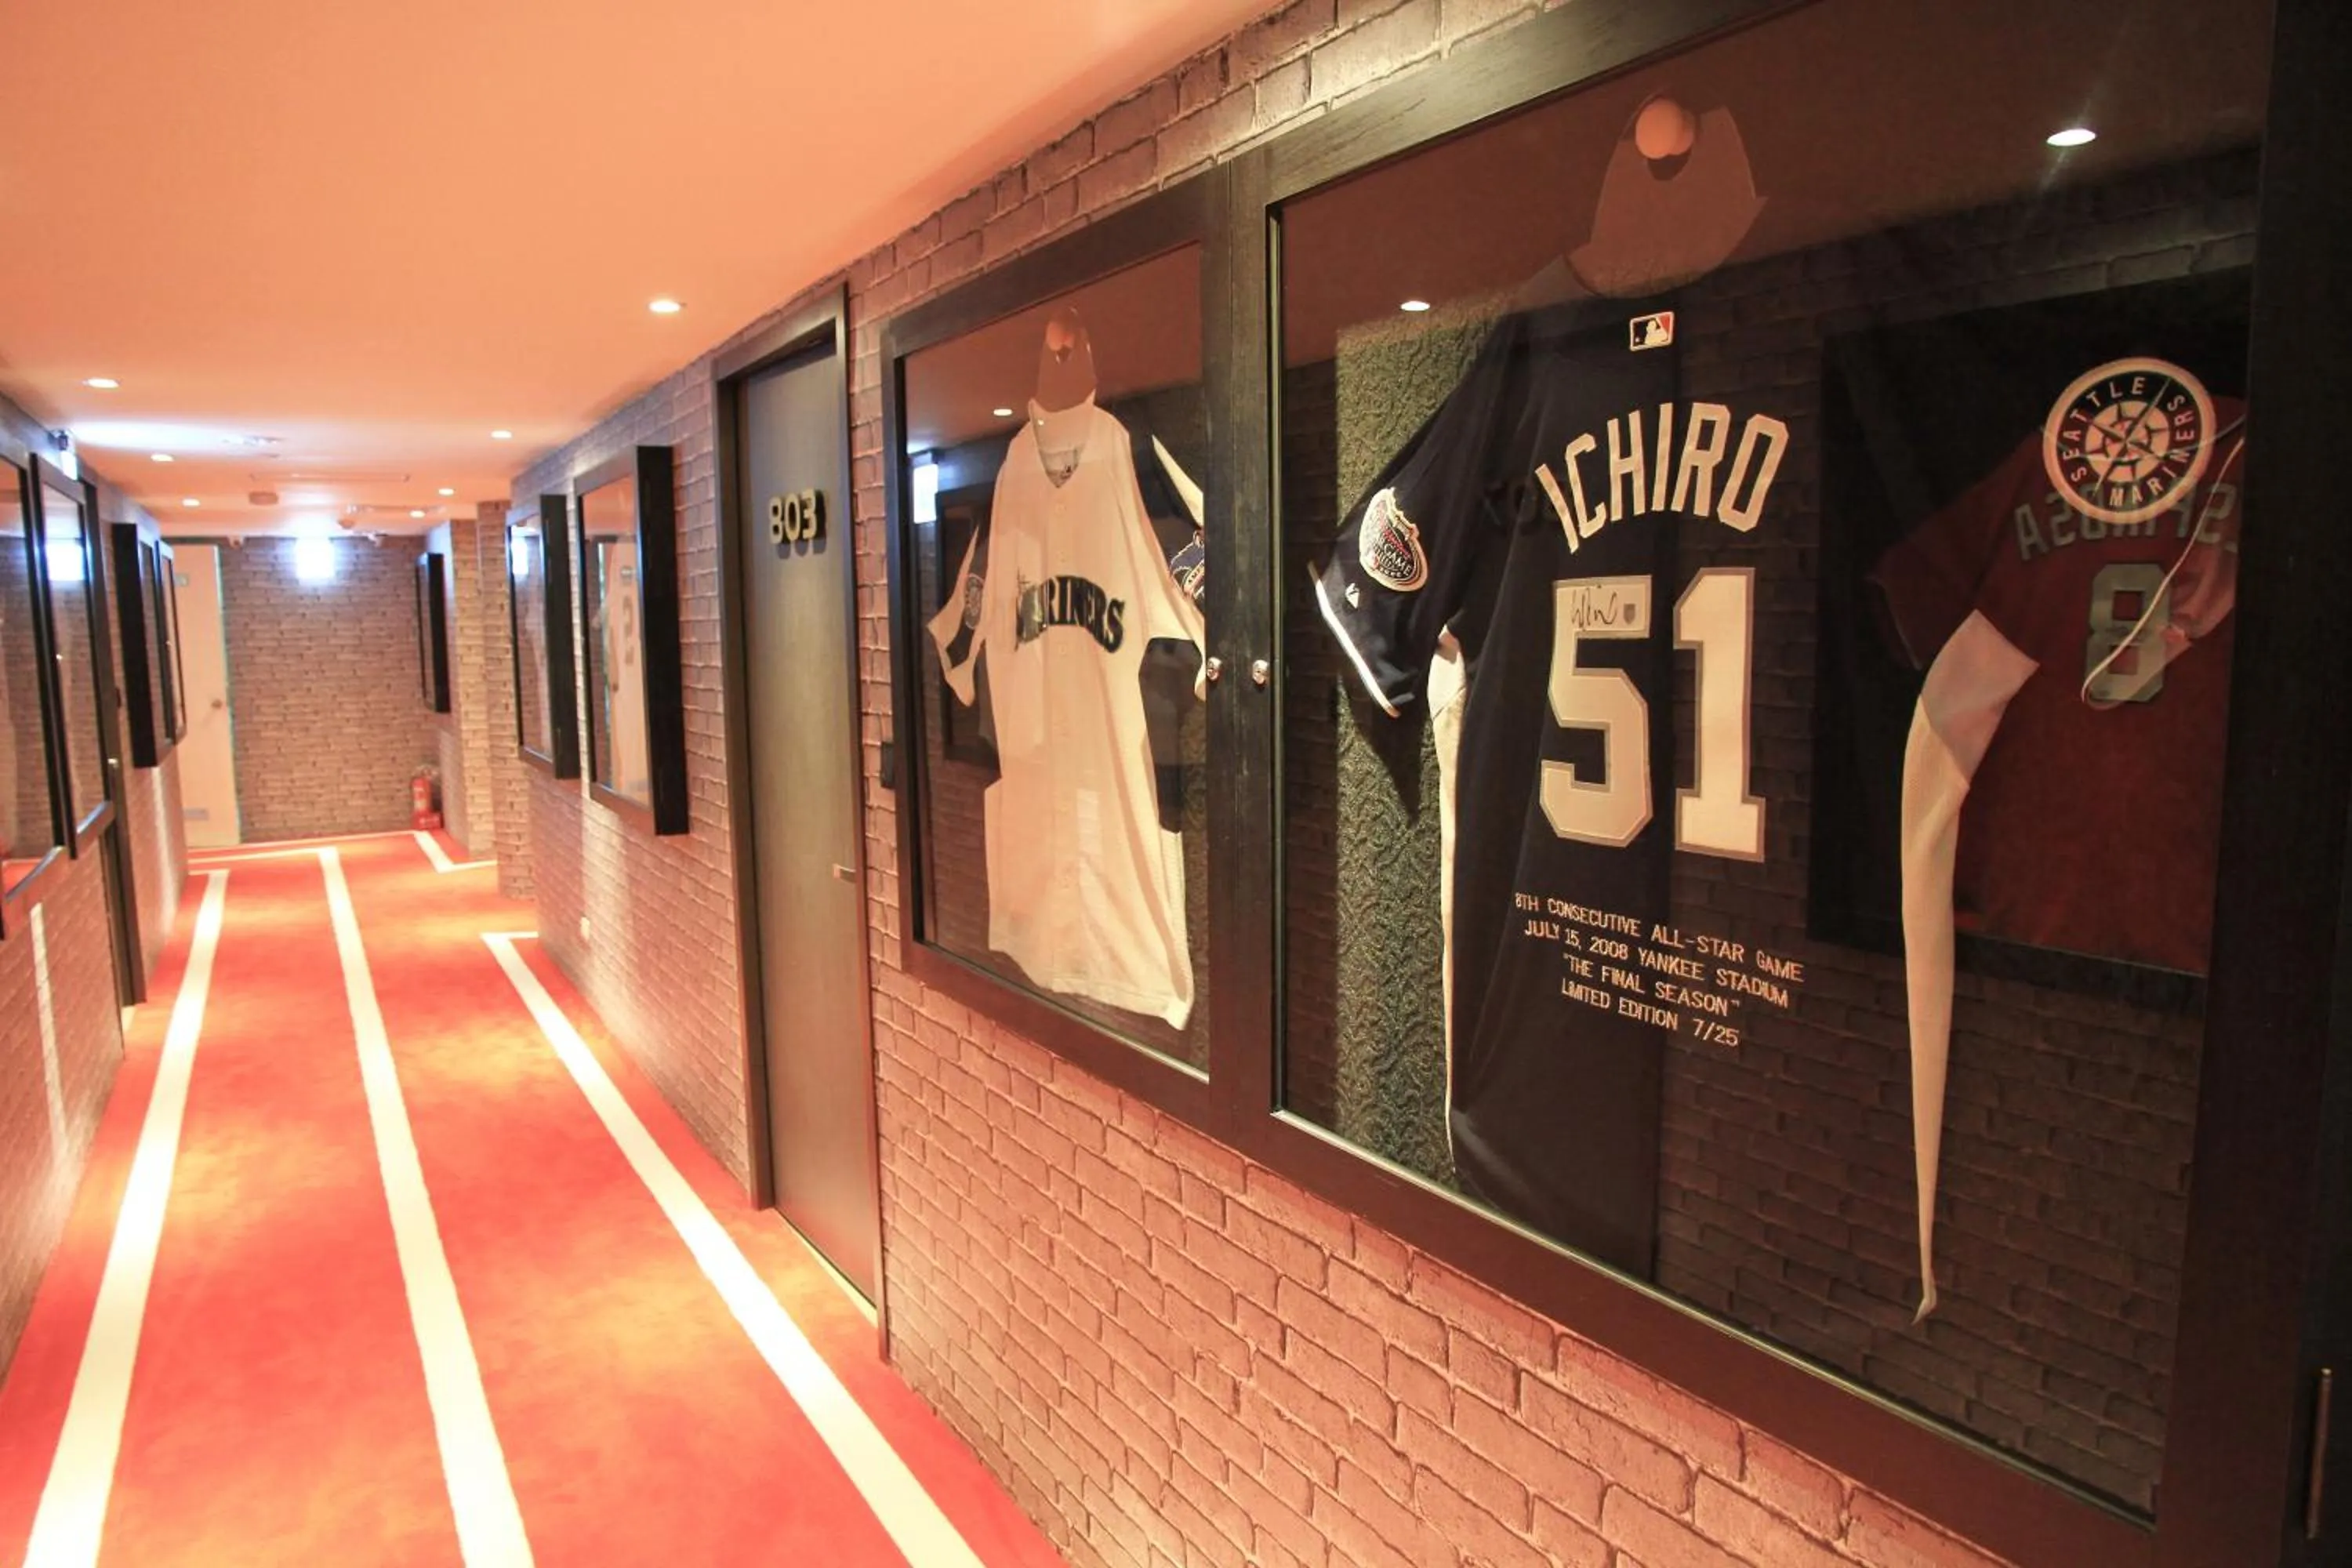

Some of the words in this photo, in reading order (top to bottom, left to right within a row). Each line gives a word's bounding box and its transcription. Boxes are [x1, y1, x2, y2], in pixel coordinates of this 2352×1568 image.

[2062, 376, 2146, 482] SEATTLE
[2109, 394, 2195, 506] MARINERS
[768, 488, 826, 545] 803
[1534, 401, 1790, 555] ICHIRO
[1015, 576, 1125, 654] RINERS
[1539, 567, 1766, 863] 51
[1515, 892, 1539, 913] 8TH
[1547, 897, 1641, 938] CONSECUTIVE
[1651, 924, 1744, 964] ALL-STAR
[1755, 949, 1805, 983] GAME
[1524, 919, 1560, 940] JULY
[1564, 928, 1581, 951] 15,
[1589, 936, 1629, 961] 2008
[1638, 948, 1705, 982] YANKEE
[1715, 967, 1789, 1009] STADIUM
[1561, 978, 1610, 1010] LIMITED
[1617, 996, 1679, 1032] EDITION
[1692, 1018, 1740, 1047] 7/25
[1563, 953, 1594, 978] "THE
[1601, 967, 1646, 995] FINAL
[1654, 981, 1740, 1017] SEASON"
